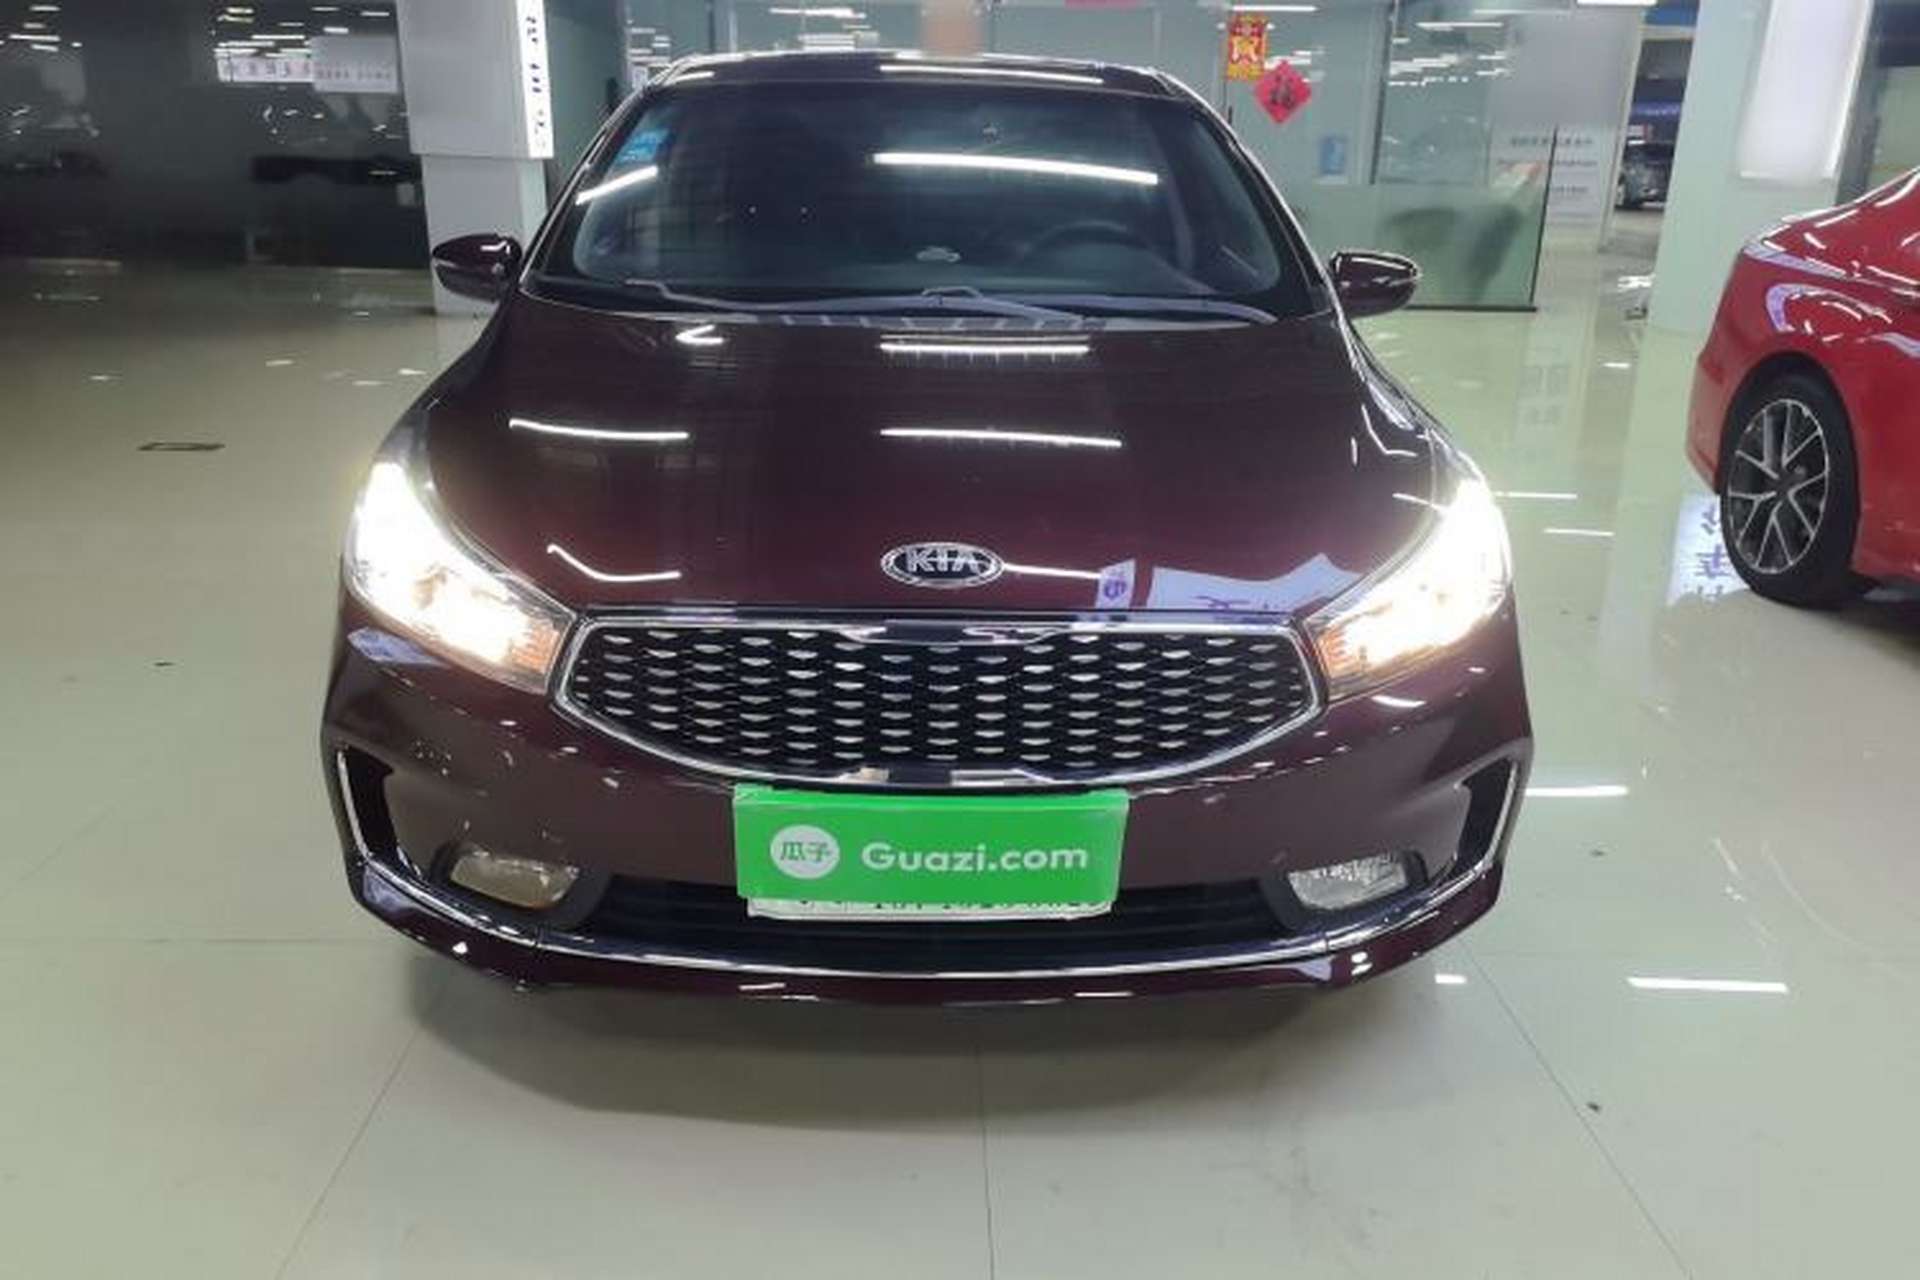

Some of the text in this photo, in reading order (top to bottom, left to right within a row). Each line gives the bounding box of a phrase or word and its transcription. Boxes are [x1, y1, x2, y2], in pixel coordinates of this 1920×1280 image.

[905, 548, 980, 573] KIA
[779, 841, 833, 863] 瓜子
[861, 841, 1088, 872] Guazi.com
